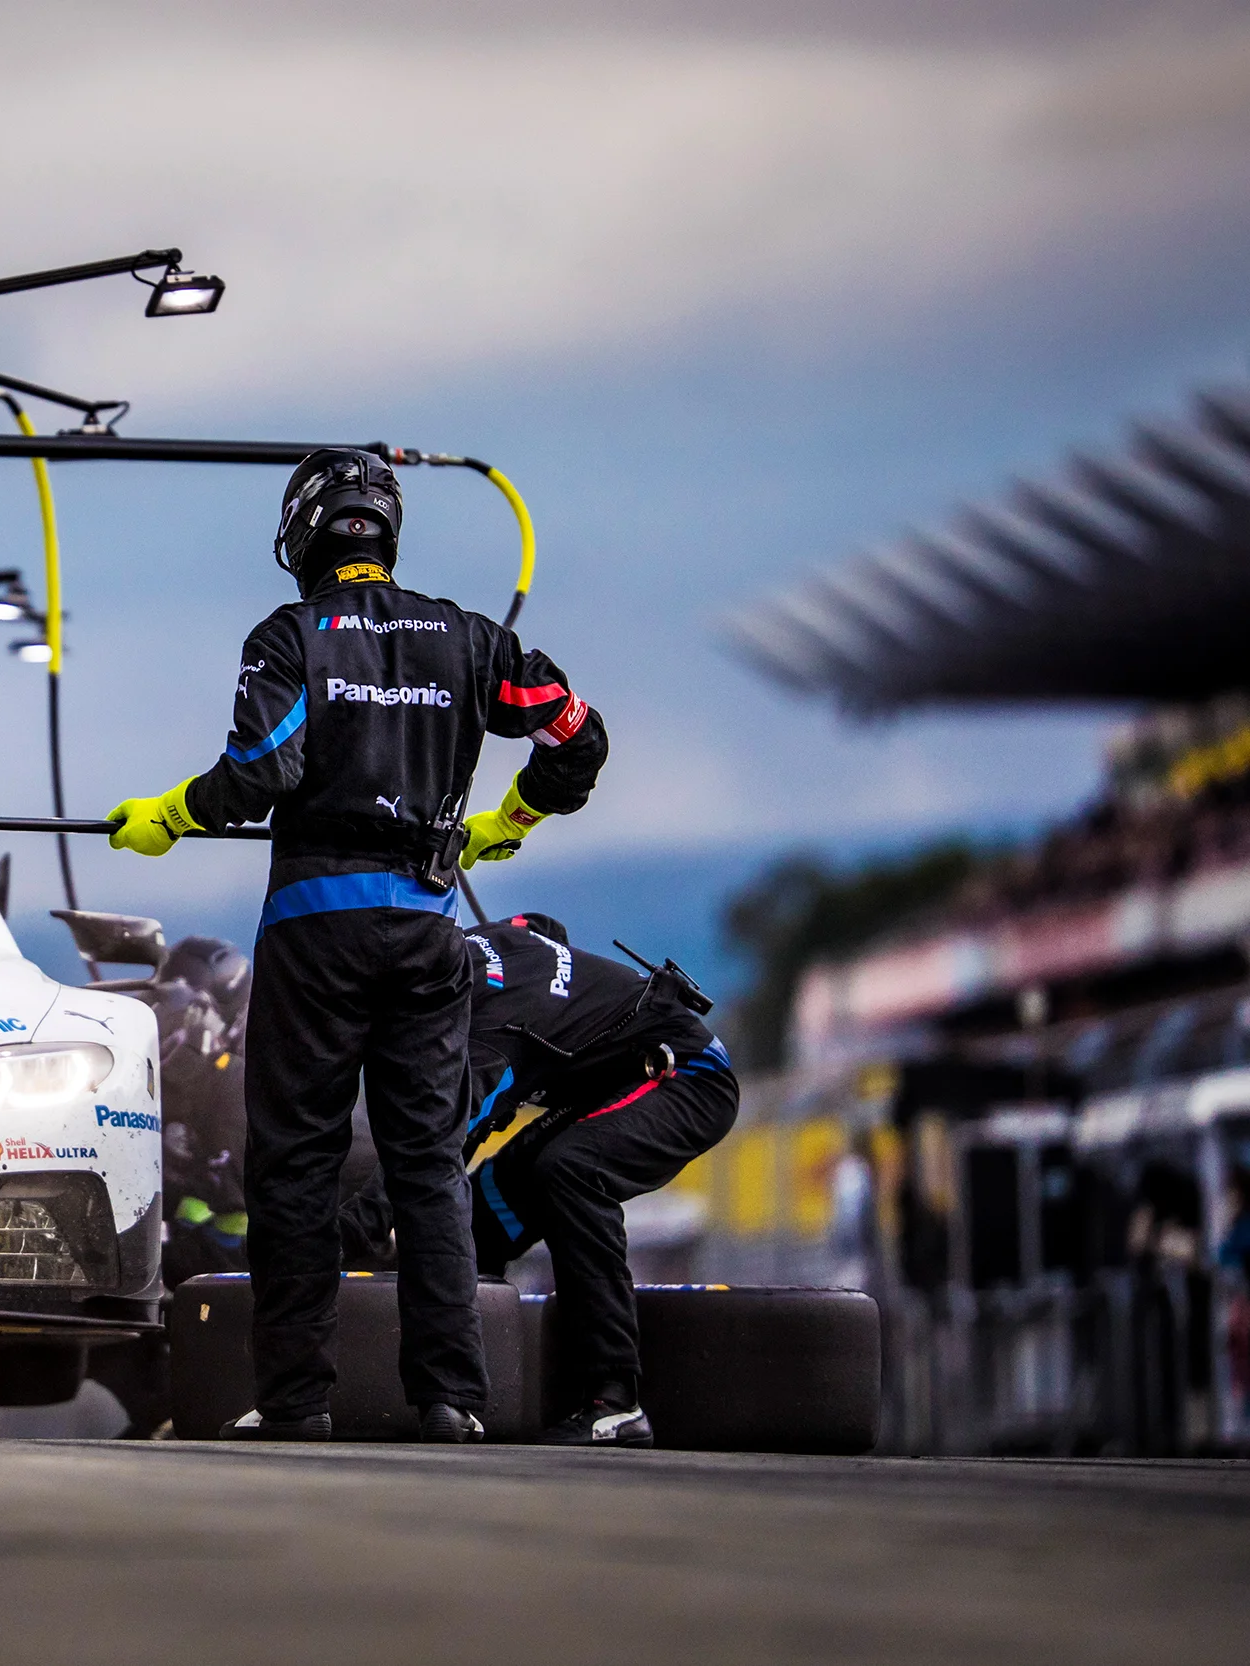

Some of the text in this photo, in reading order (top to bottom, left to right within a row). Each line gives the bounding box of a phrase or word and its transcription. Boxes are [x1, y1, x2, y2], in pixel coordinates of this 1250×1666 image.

[327, 678, 452, 708] Panasonic
[5, 1137, 26, 1147] Shell
[7, 1142, 98, 1159] HELIX ULTRA
